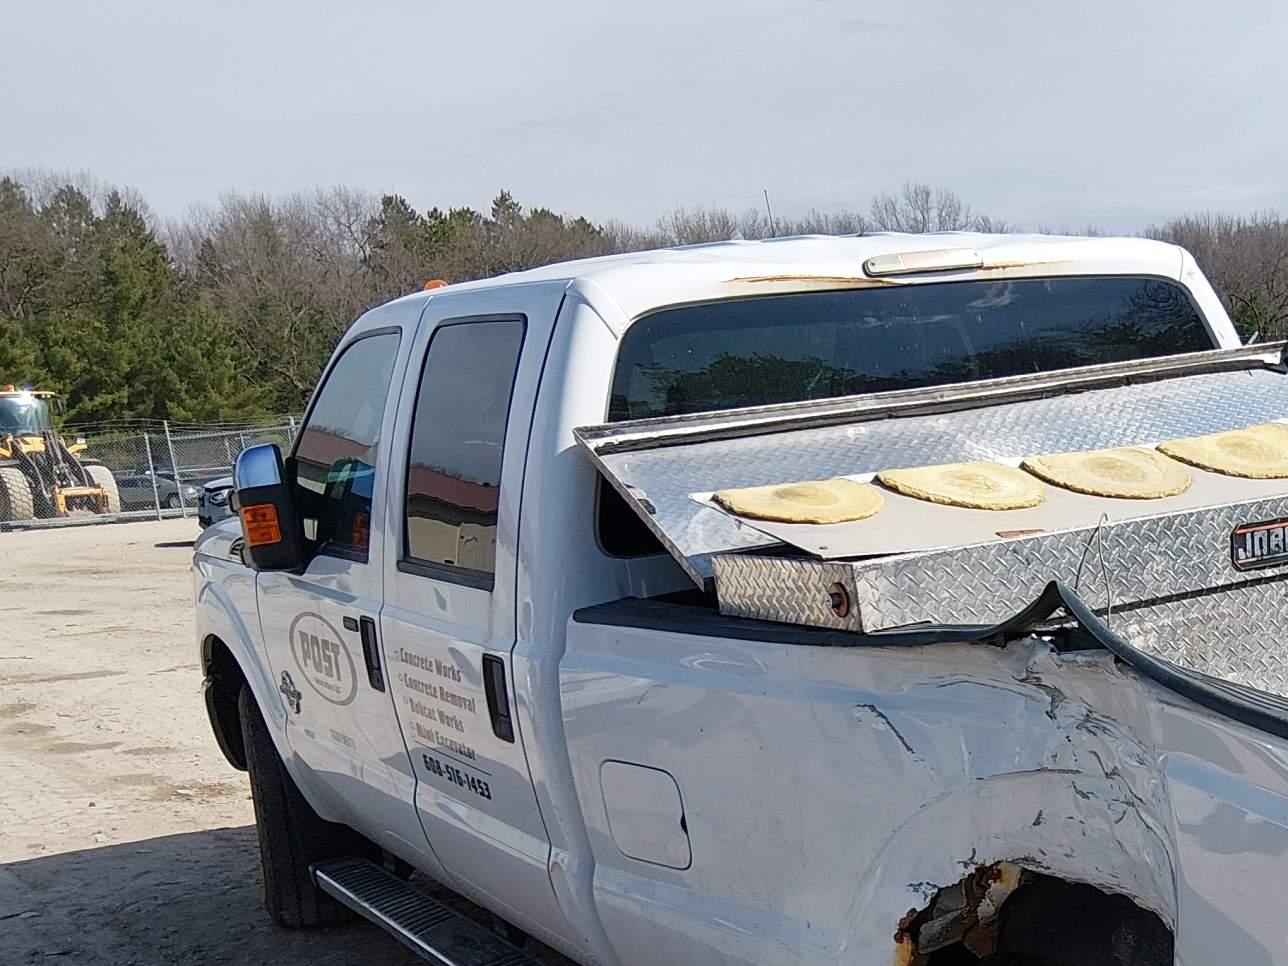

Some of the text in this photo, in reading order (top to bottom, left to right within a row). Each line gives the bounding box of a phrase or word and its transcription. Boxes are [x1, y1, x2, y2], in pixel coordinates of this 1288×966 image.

[299, 630, 342, 682] POST
[401, 647, 462, 683] Concrete Works
[404, 672, 476, 714] Concrete Removal
[409, 697, 465, 734] Bobcat Works
[423, 753, 492, 801] 608-516-1453
